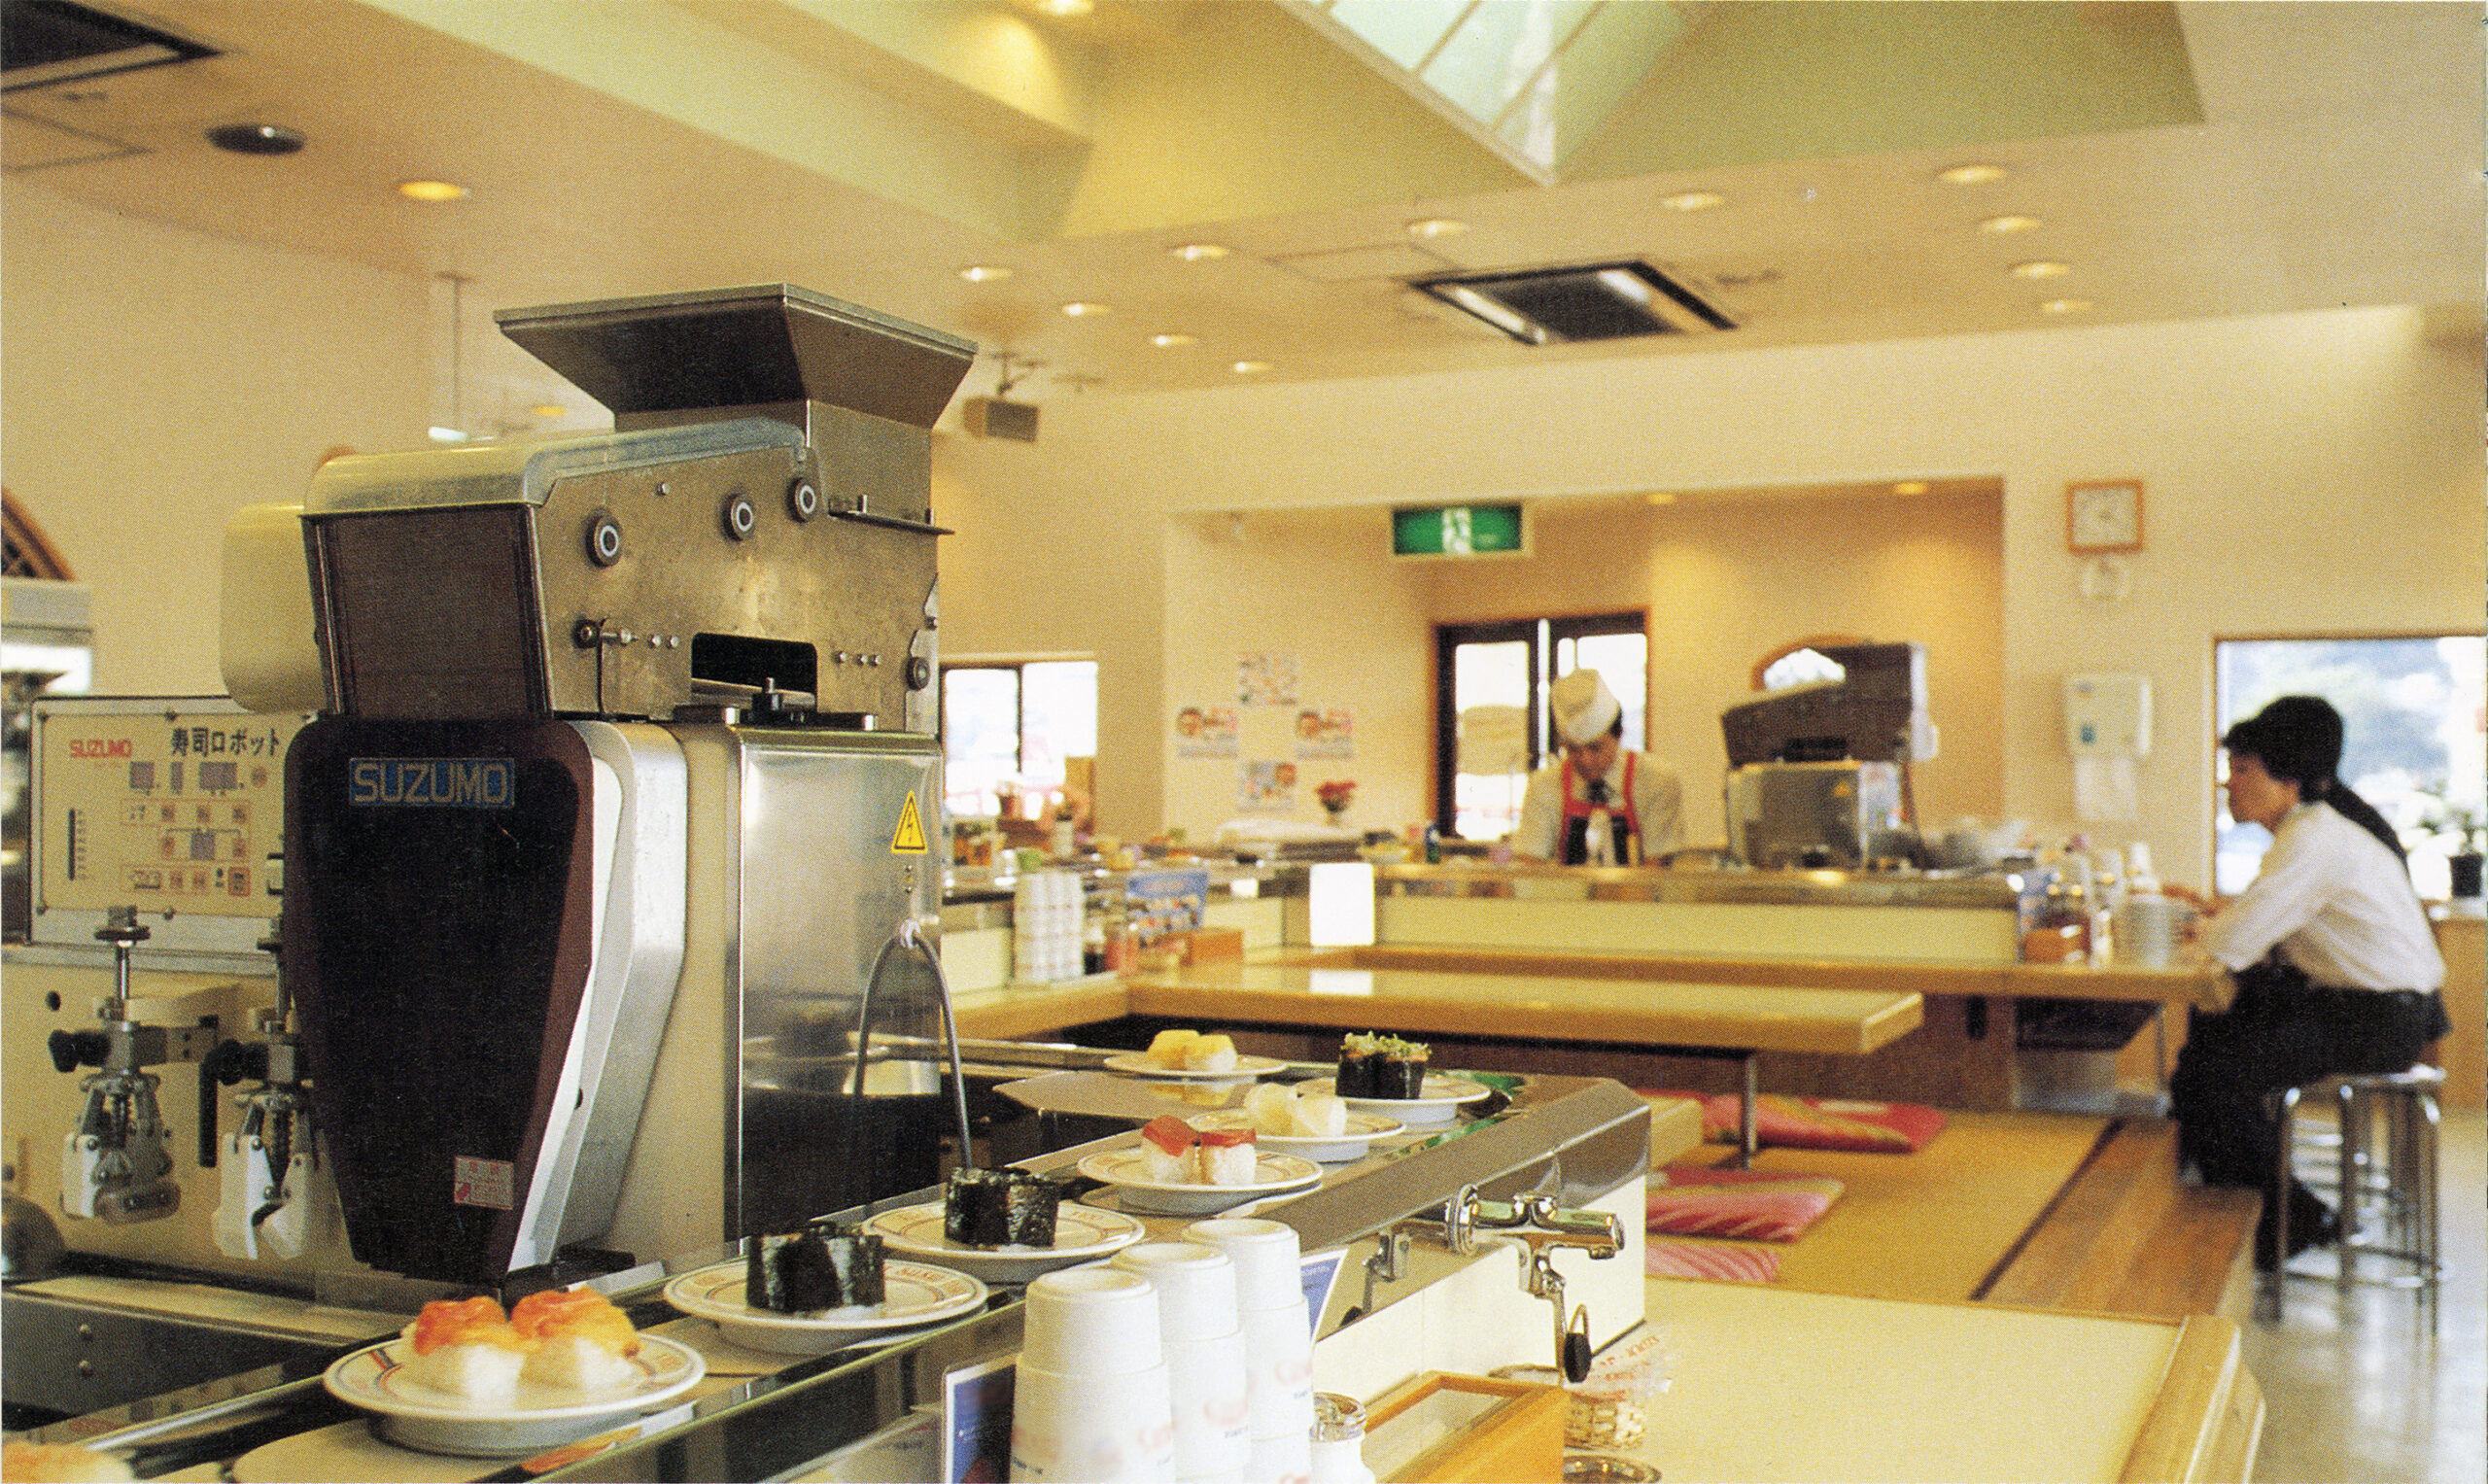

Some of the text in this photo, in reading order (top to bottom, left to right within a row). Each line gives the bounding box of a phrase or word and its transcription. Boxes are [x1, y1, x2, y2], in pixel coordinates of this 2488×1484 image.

[69, 739, 132, 758] SUZUMO
[171, 727, 279, 757] 寿司ロボット
[354, 763, 507, 804] SUZUMO
